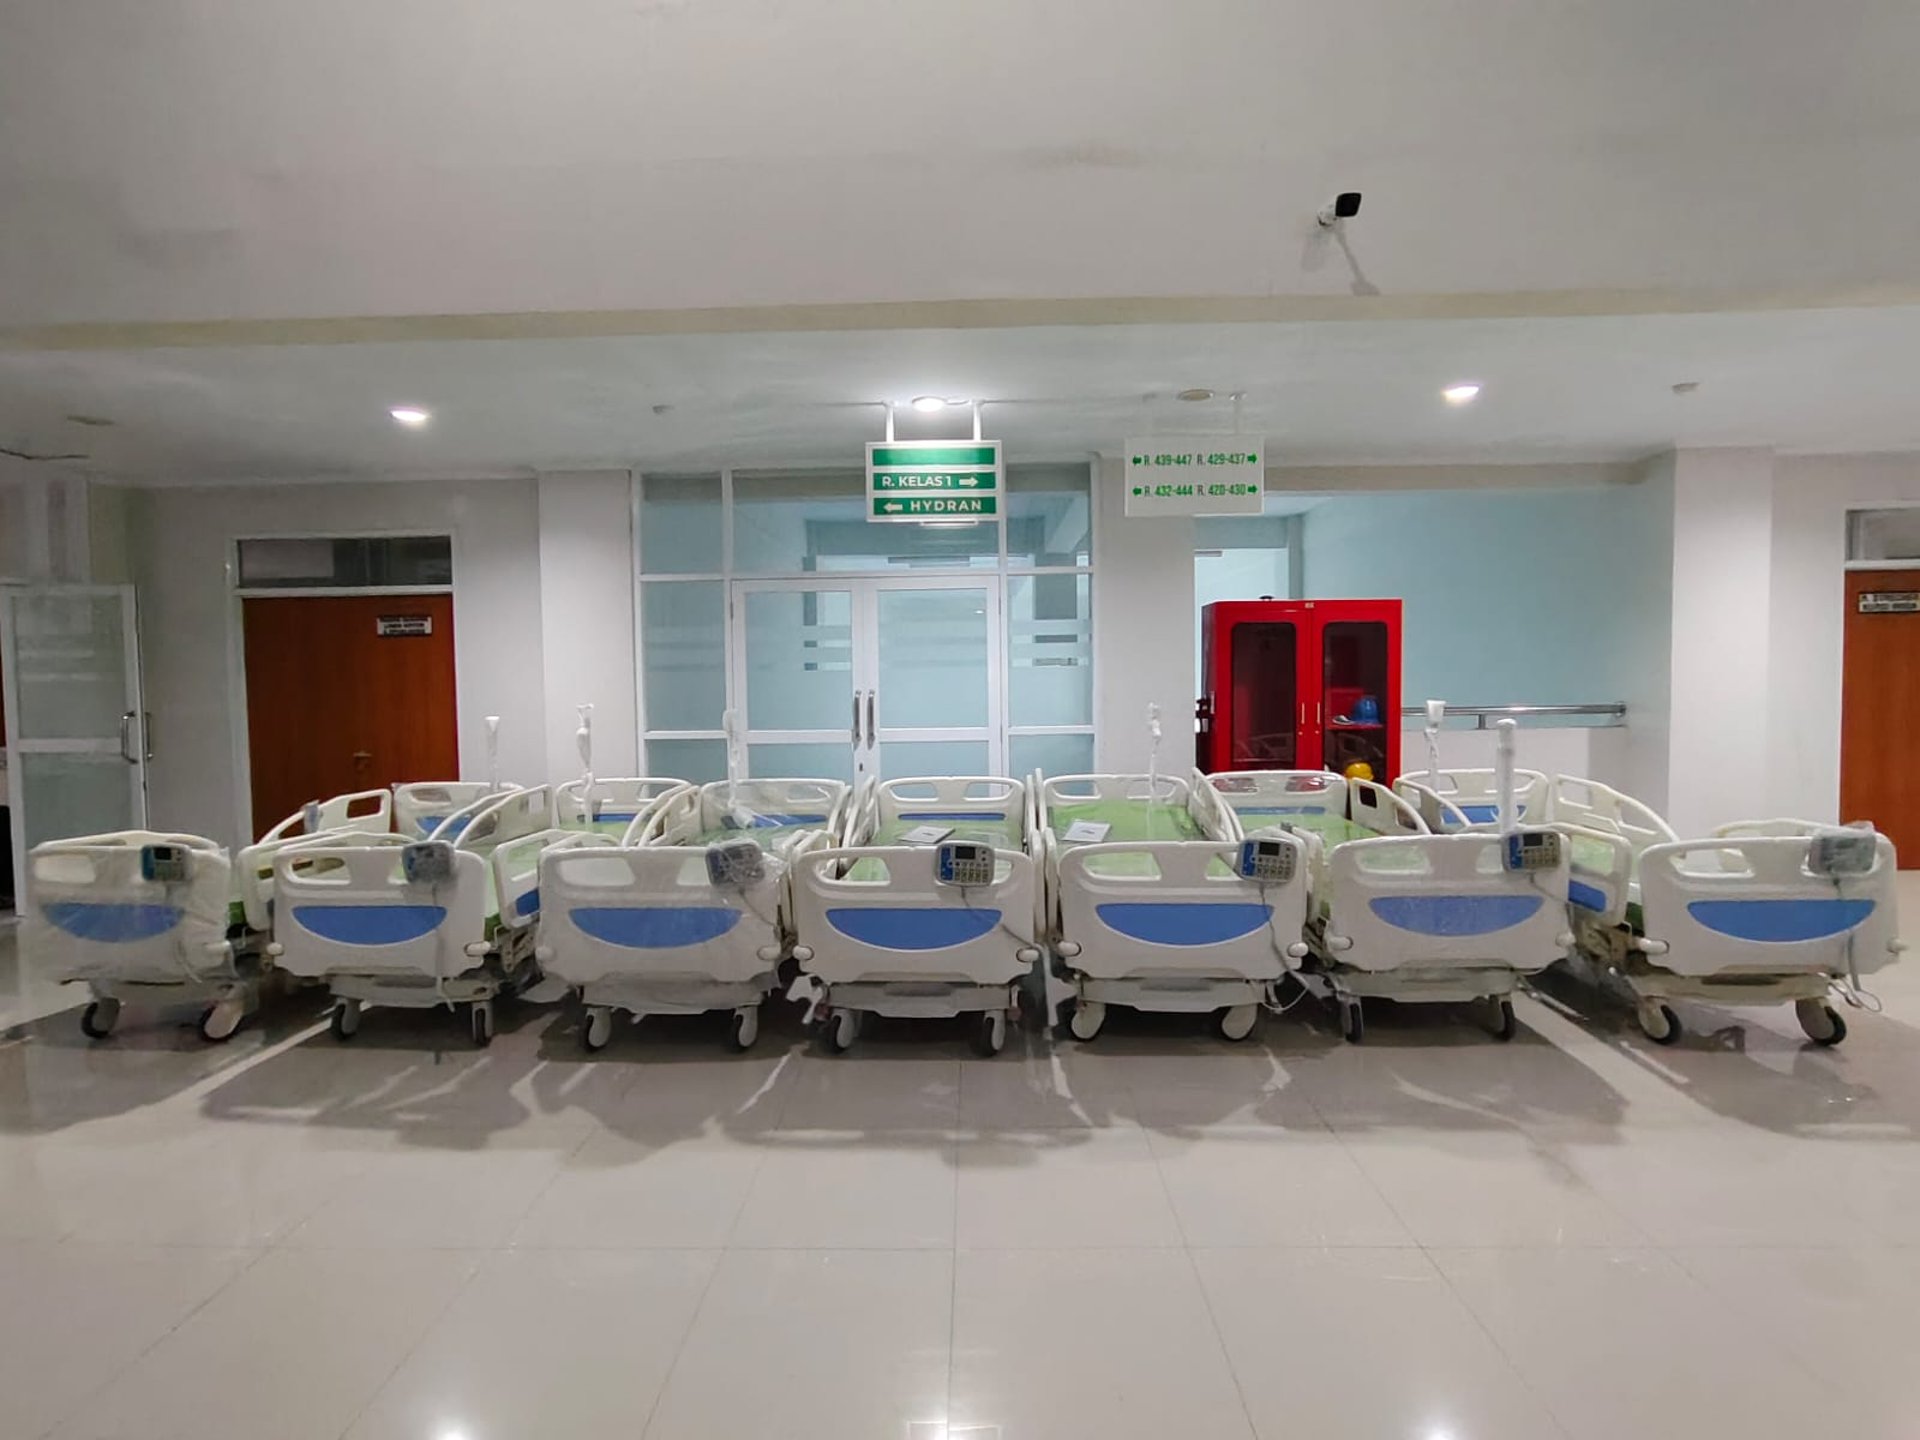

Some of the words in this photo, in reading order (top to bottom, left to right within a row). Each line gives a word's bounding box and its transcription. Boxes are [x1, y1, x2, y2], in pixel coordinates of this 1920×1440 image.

[1154, 454, 1192, 465] 439-447
[1197, 453, 1206, 465] R.
[1207, 453, 1245, 464] 429-437
[882, 476, 895, 487] R.
[898, 476, 942, 487] KELAS
[946, 476, 952, 486] 1
[910, 501, 982, 512] HYDRAN
